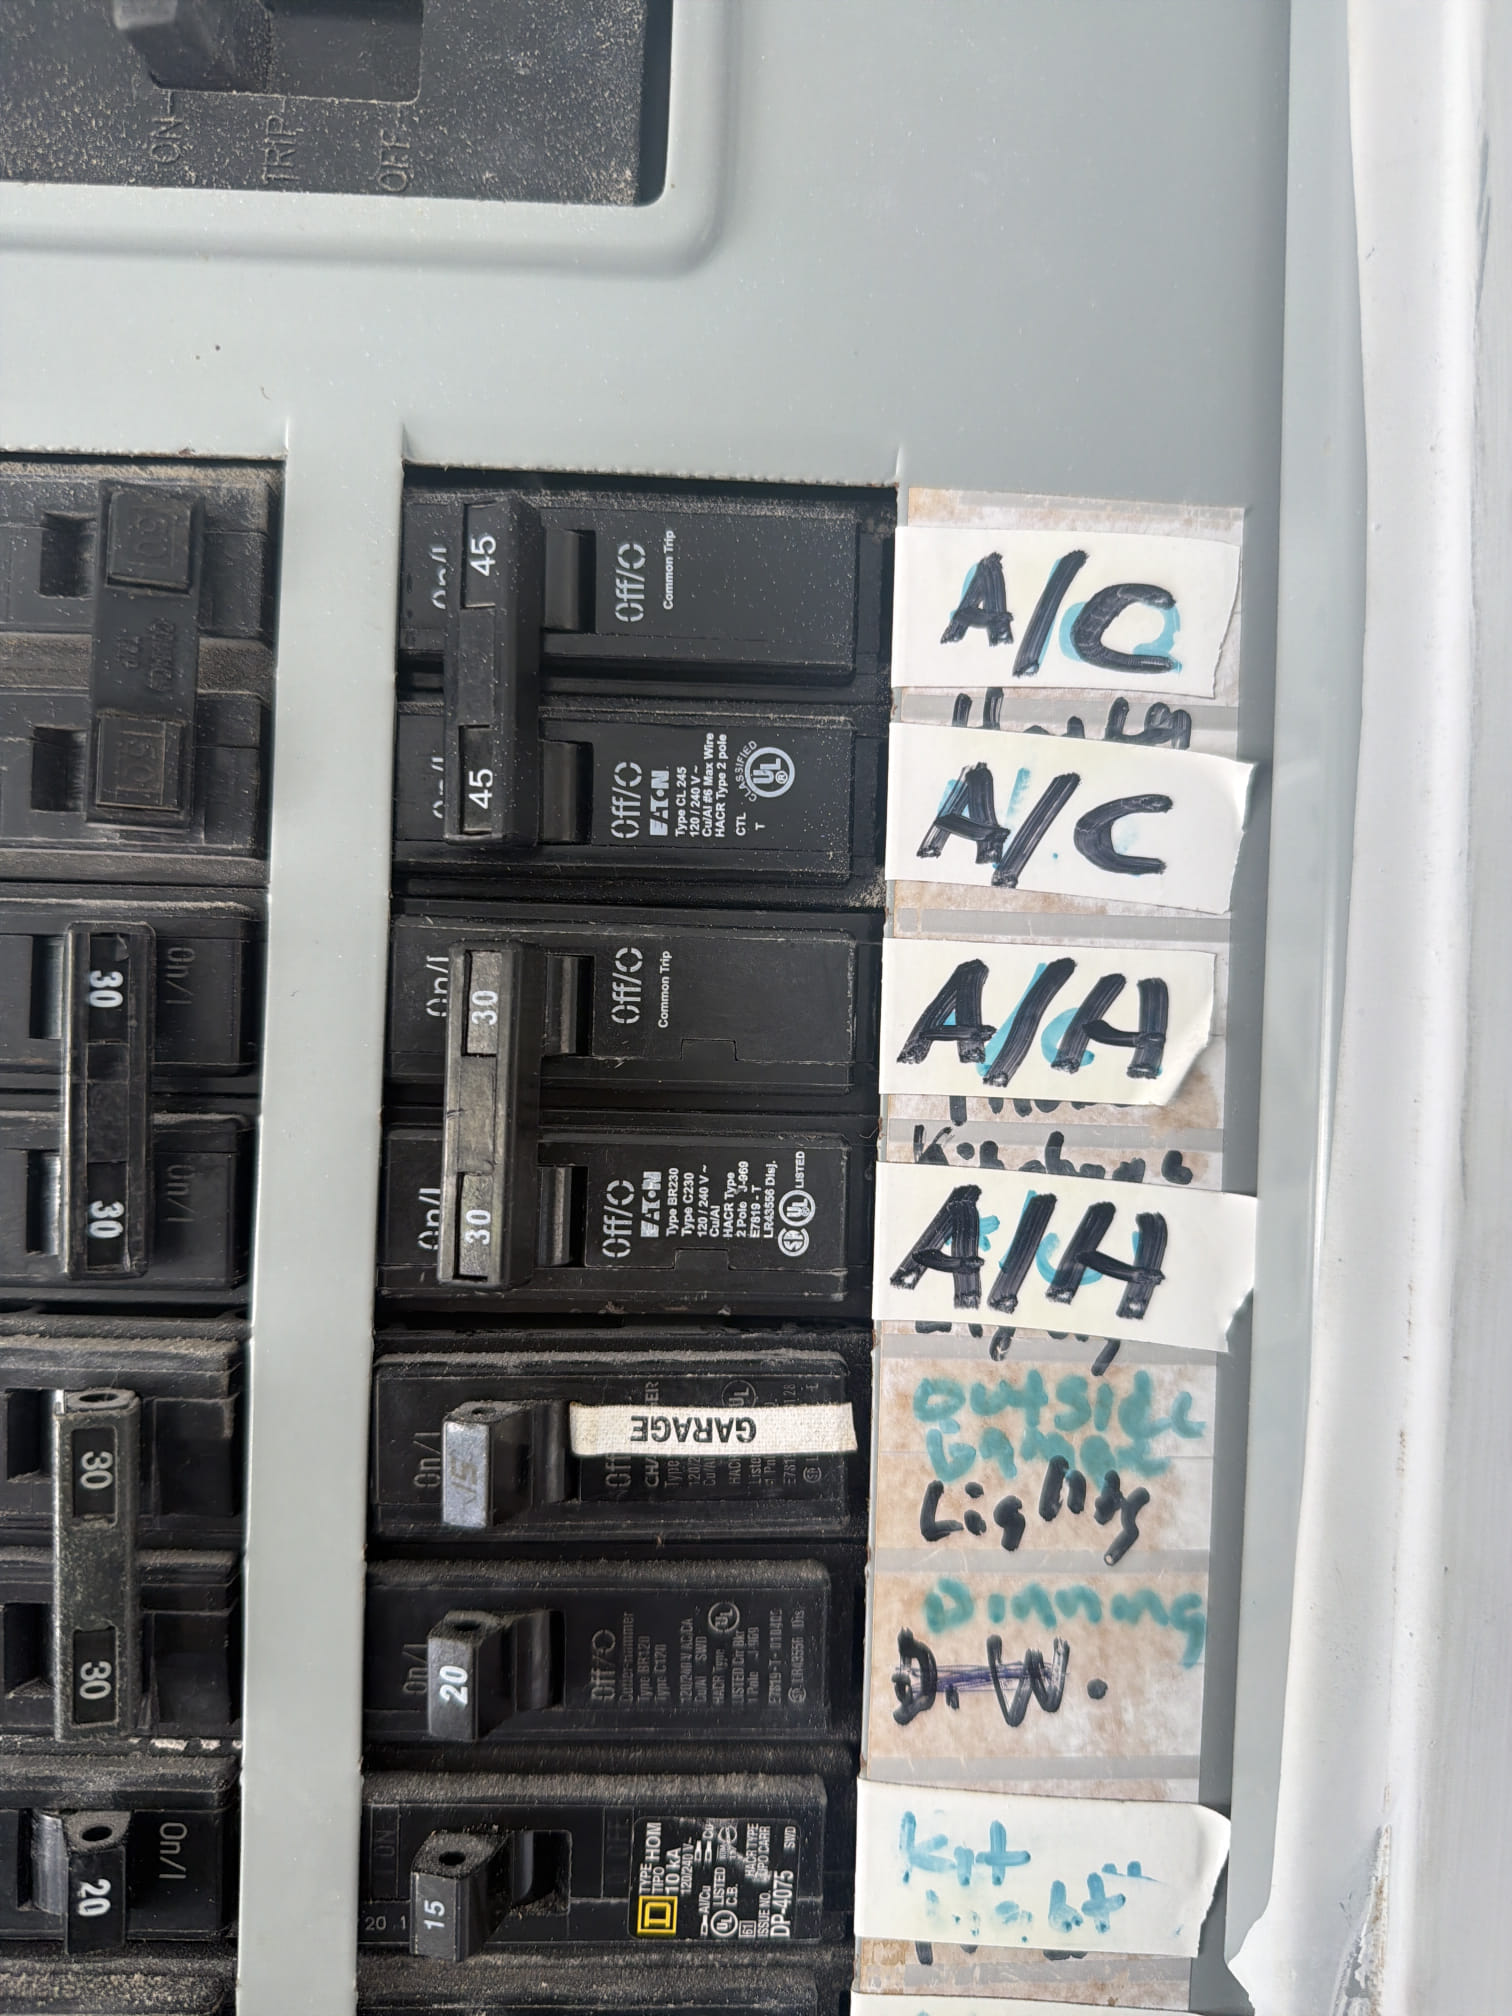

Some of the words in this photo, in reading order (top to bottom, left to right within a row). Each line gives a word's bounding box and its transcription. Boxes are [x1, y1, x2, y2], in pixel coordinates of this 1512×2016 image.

[151, 117, 183, 164] ON
[263, 114, 302, 185] TRIP
[378, 129, 412, 193] OFF
[470, 535, 497, 577] 45
[662, 529, 677, 554] Trip
[662, 556, 675, 610] Common
[941, 550, 1178, 677] A/C
[704, 733, 716, 760] Wire
[717, 733, 730, 760] pole
[469, 767, 494, 809] 45
[676, 766, 688, 788] 245
[703, 762, 715, 787] Max
[716, 772, 730, 801] Type
[734, 740, 759, 803] CLASSIFIED
[649, 767, 670, 836] EATON
[676, 789, 688, 807] CL
[690, 787, 701, 809] 240
[703, 789, 714, 804] #6
[675, 809, 688, 838] Type
[690, 817, 701, 838] 120
[703, 806, 714, 838] Cu/Al
[716, 803, 728, 838] HACR
[735, 811, 747, 837] CTL
[917, 762, 1174, 888] A/C
[659, 950, 673, 973] Trip
[90, 970, 124, 1008] 30
[658, 976, 669, 1028] Common
[471, 988, 498, 1026] 30
[897, 958, 1169, 1087] A/H
[723, 1172, 736, 1201] Type
[794, 1151, 806, 1189] LISTED
[667, 1168, 680, 1206] BR230
[682, 1172, 695, 1204] C230
[697, 1187, 709, 1208] 240
[90, 1200, 124, 1239] 30
[641, 1171, 662, 1238] EATON
[722, 1203, 734, 1238] HACR
[736, 1201, 748, 1228] Pole
[750, 1204, 761, 1238] E7819
[762, 1188, 776, 1238] LR43556
[465, 1208, 493, 1245] 30
[665, 1208, 680, 1238] Type
[681, 1207, 695, 1237] Type
[697, 1217, 708, 1238] 120
[890, 1184, 1169, 1319] A/H
[630, 1416, 758, 1443] GARAGE
[80, 1451, 114, 1490] 30
[79, 1661, 113, 1701] 30
[440, 1664, 468, 1705] 20
[645, 1822, 662, 1861] HOM
[746, 1823, 759, 1848] TYPE
[783, 1826, 796, 1849] SWD
[666, 1847, 681, 1869] kA
[681, 1853, 694, 1894] 120/240
[639, 1863, 653, 1894] TYPE
[652, 1867, 664, 1894] TIPO
[665, 1873, 681, 1895] 10
[713, 1866, 726, 1906] LISTED
[726, 1883, 738, 1906] C.B.
[77, 1878, 112, 1918] 20
[770, 1870, 794, 1938] DP-4075
[364, 1915, 387, 1931] 20
[423, 1899, 446, 1931] 15
[759, 1909, 770, 1938] ISSUE
